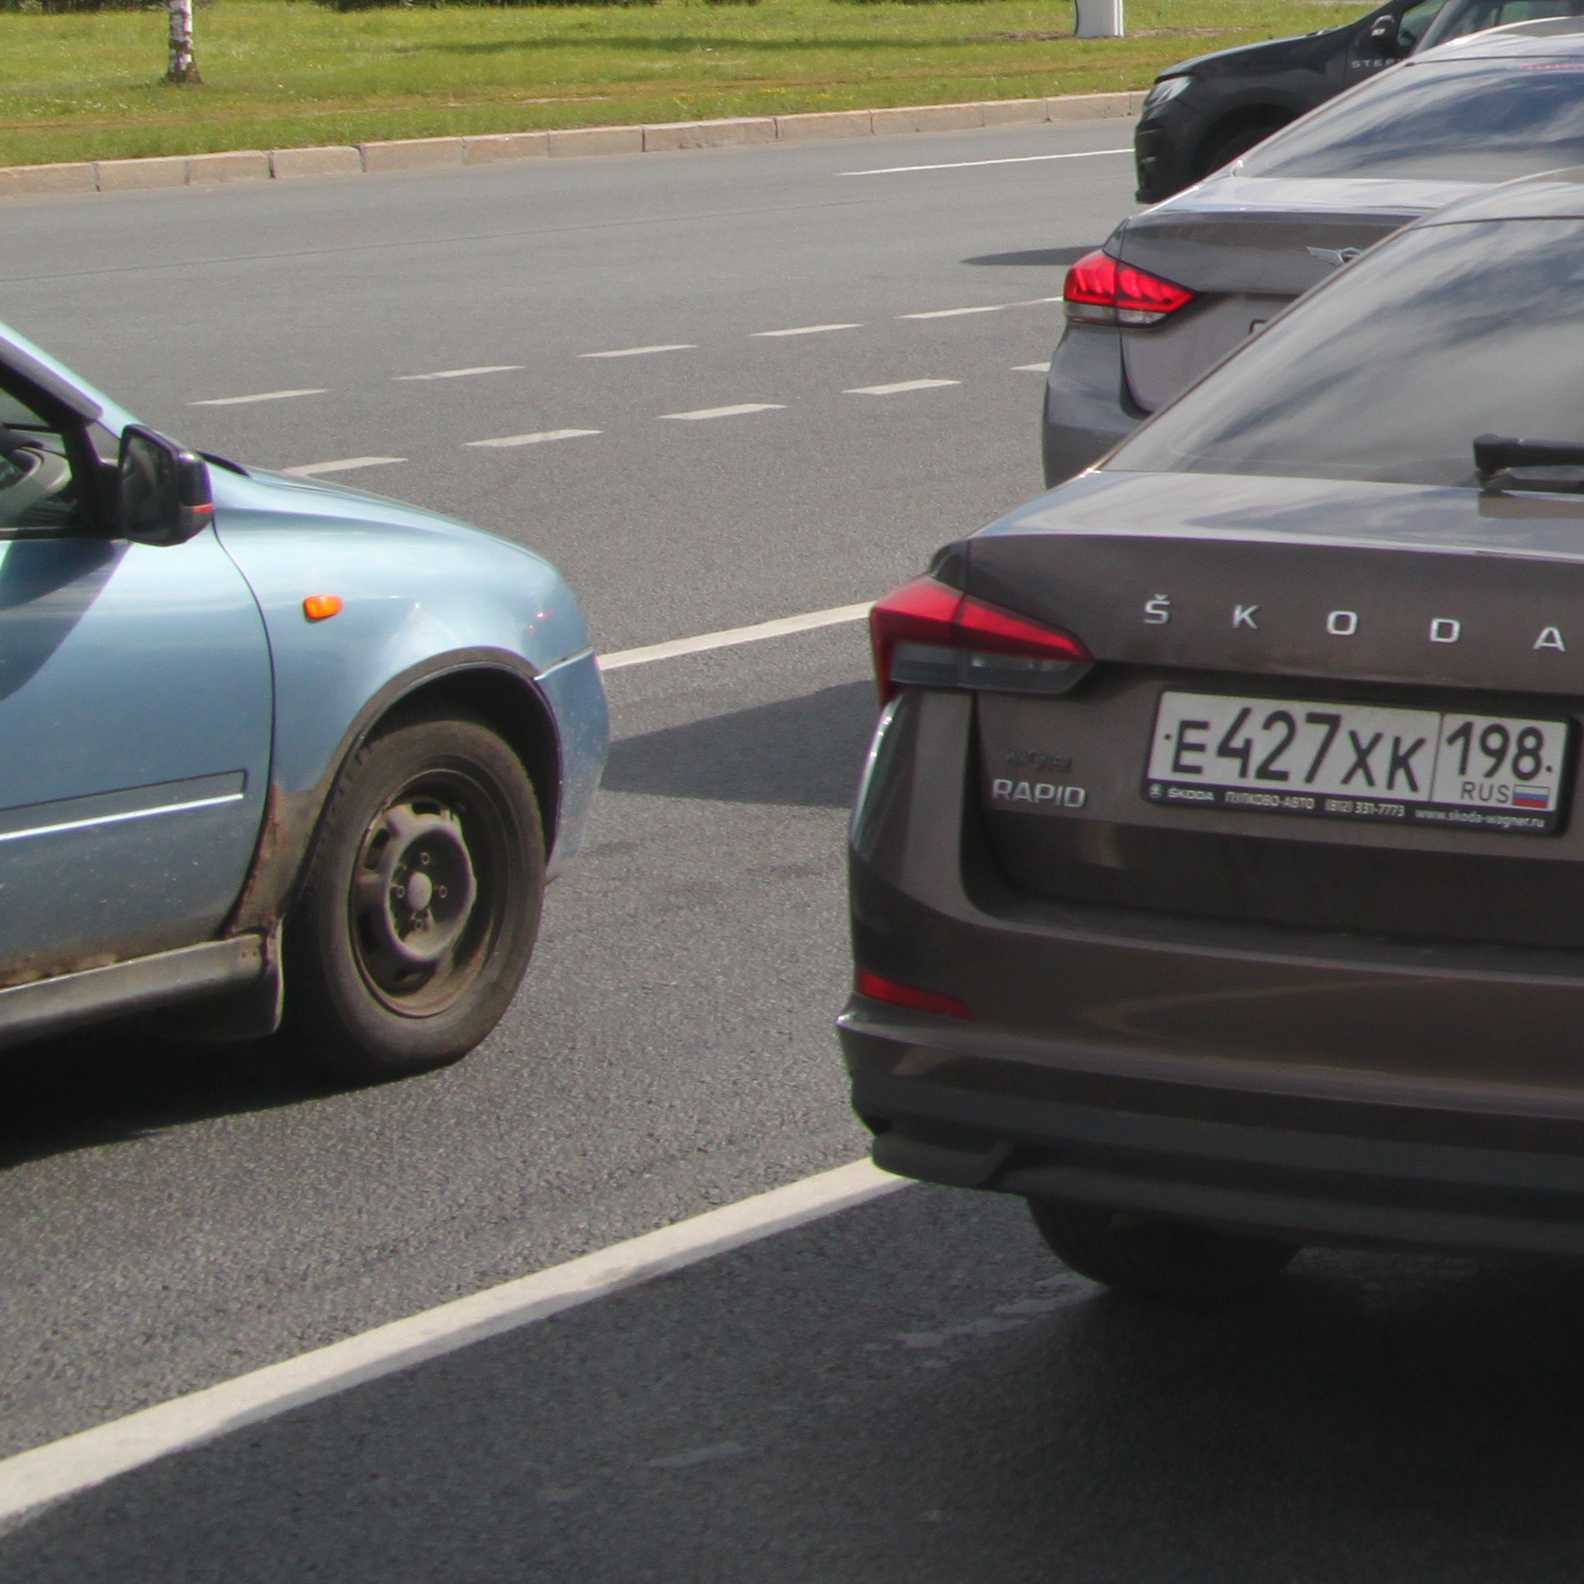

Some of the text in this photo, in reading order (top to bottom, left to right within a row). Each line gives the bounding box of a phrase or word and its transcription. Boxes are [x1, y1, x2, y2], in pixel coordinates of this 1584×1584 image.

[1143, 594, 1567, 653] ŠKODA
[1171, 706, 1545, 794] Е427ХК 198
[992, 778, 1086, 808] RAPID
[1459, 780, 1510, 805] RUS
[1414, 808, 1545, 829] www.skoda-wagner.ru
